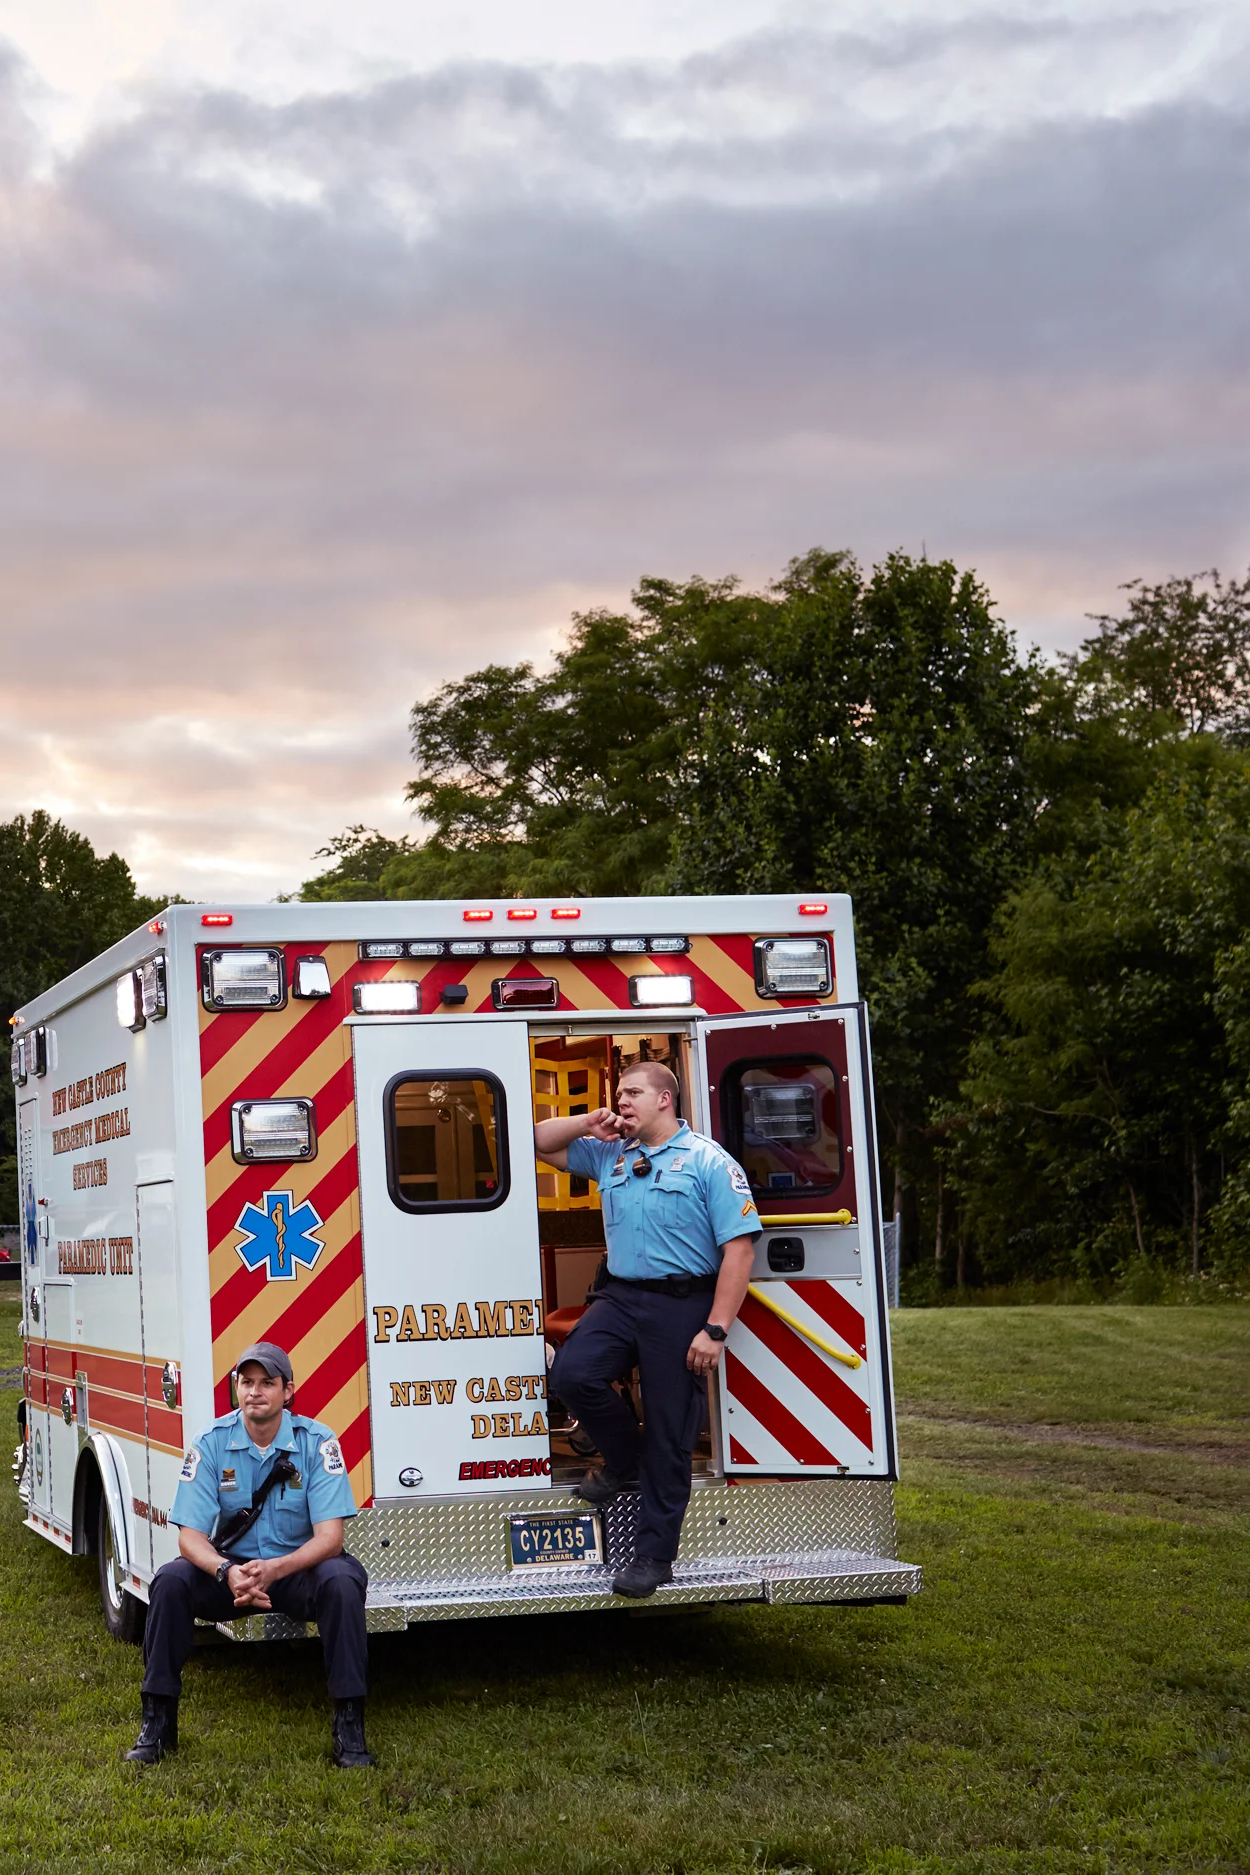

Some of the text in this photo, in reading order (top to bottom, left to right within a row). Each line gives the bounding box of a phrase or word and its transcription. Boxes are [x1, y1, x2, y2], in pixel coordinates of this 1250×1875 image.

[52, 1062, 126, 1116] NEW CASTLE COUNTY
[52, 1107, 130, 1155] EMERGENCY MEDICAL
[73, 1158, 108, 1191] SERVICES
[58, 1237, 133, 1276] PARAMEDIC UNIT
[390, 1380, 457, 1407] NEW
[520, 1526, 585, 1551] CY2135
[535, 1553, 574, 1562] DELAWARE
